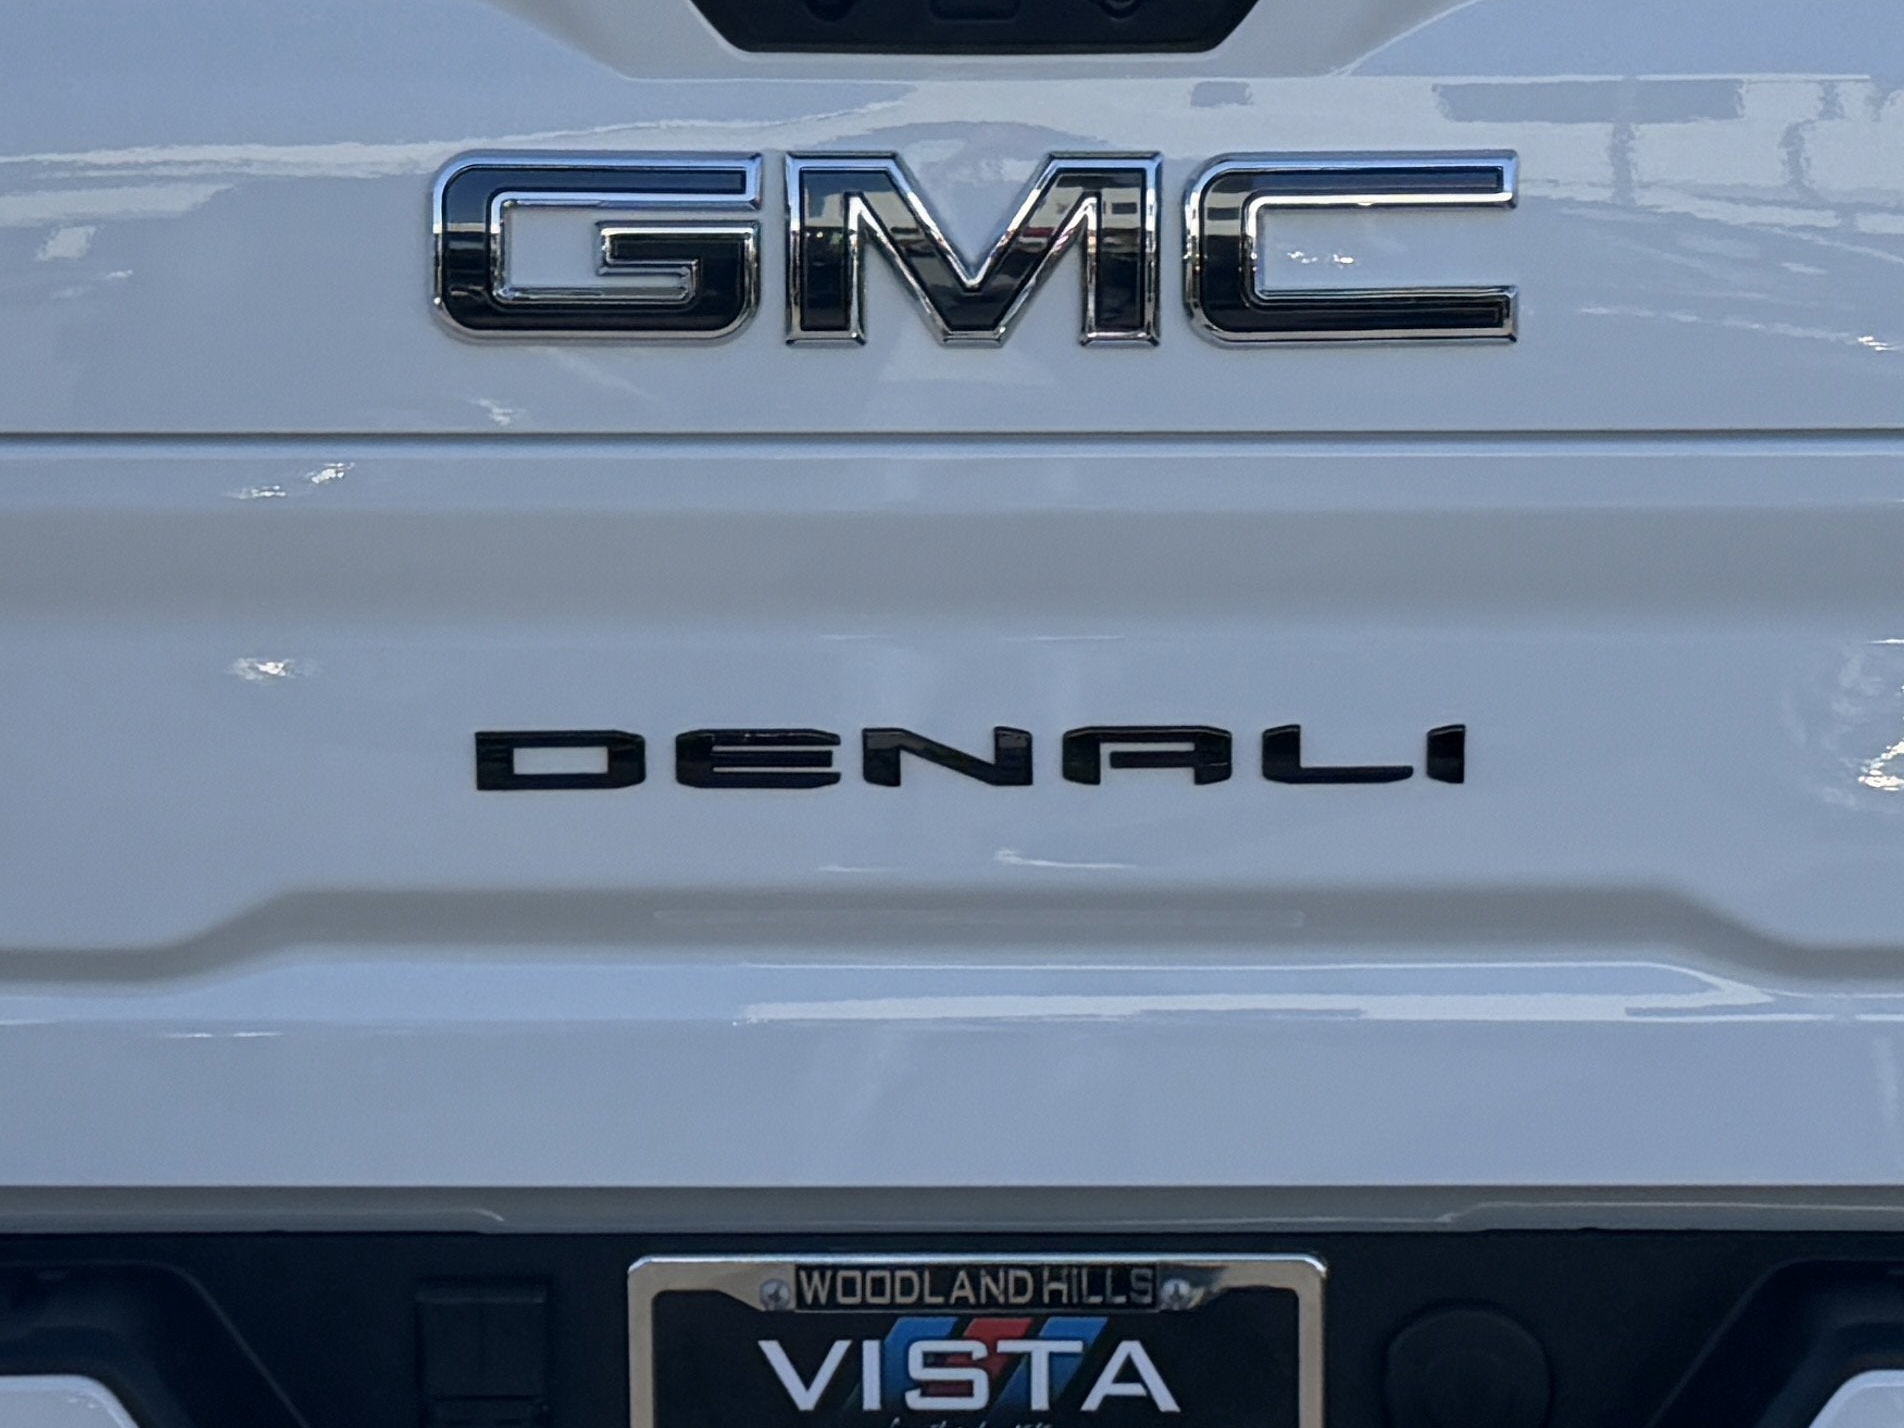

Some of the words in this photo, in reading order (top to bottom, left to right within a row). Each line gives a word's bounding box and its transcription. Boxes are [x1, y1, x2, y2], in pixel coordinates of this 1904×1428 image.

[431, 147, 1518, 348] GMC
[474, 723, 1467, 792] DENALI
[798, 1268, 1035, 1305] WOODLAND
[1042, 1267, 1154, 1305] HILLS
[757, 1339, 1182, 1412] VISTA
